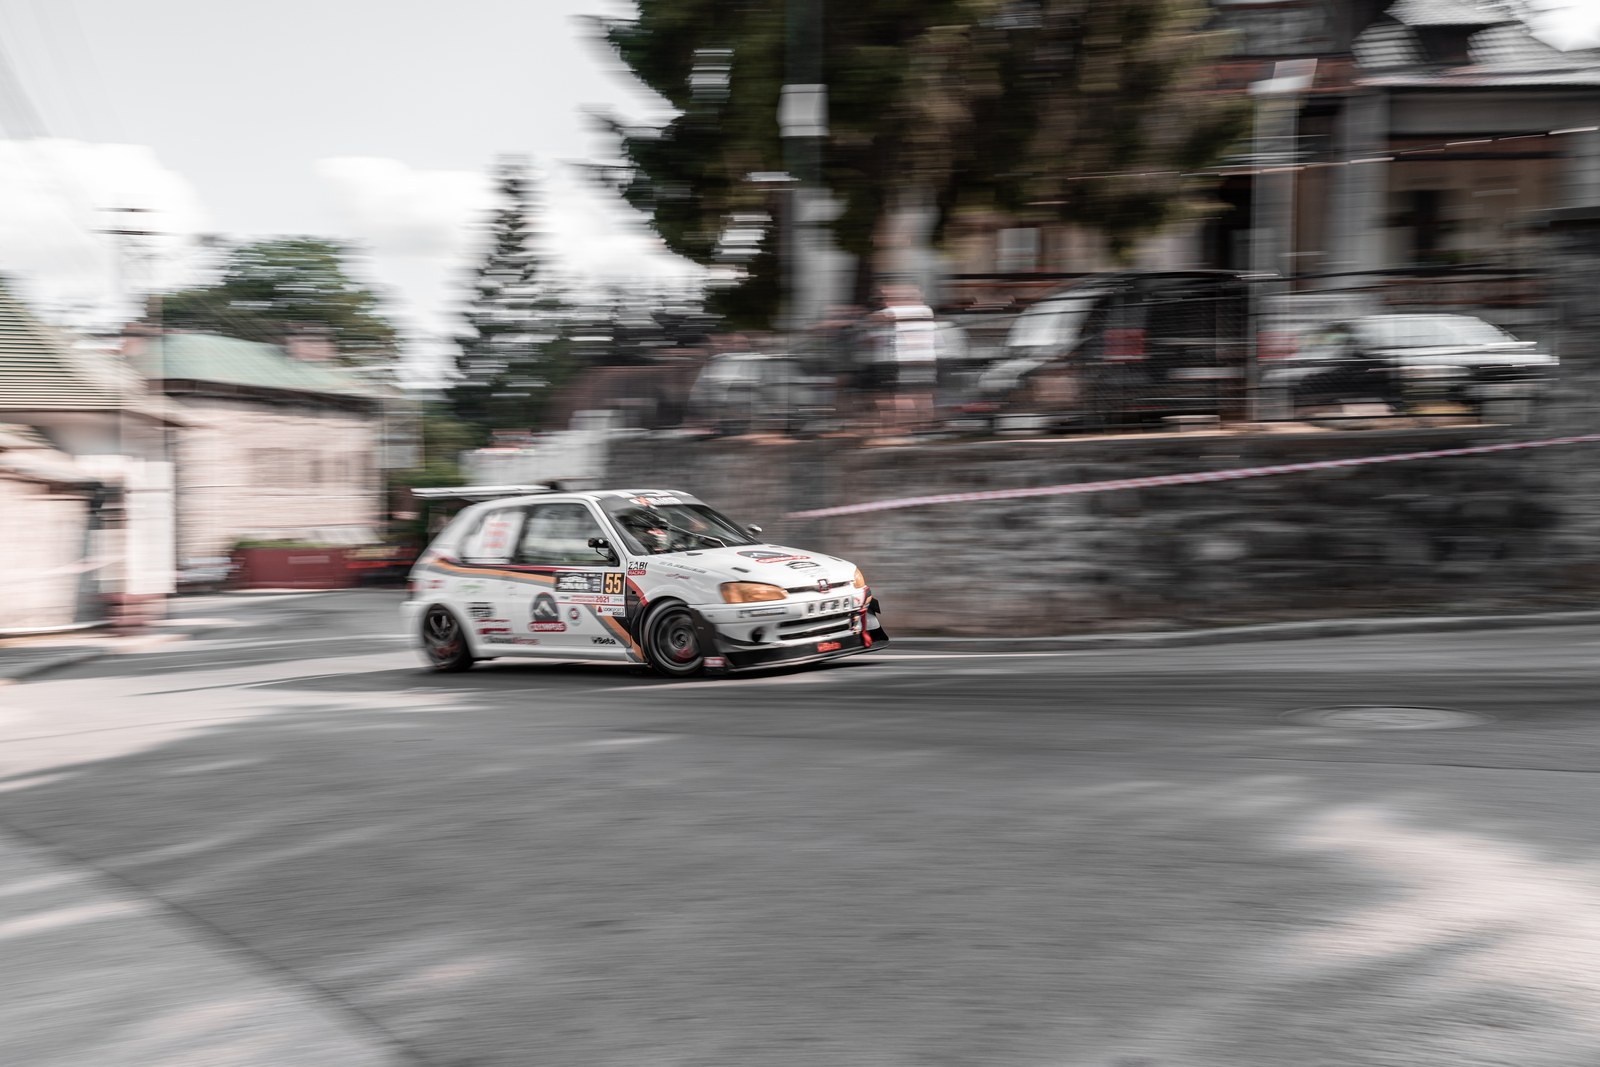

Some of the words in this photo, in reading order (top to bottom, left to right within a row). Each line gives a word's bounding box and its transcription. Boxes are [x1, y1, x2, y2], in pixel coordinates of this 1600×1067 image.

[628, 561, 648, 569] ZABI
[605, 573, 622, 593] 55
[598, 636, 616, 644] Beta
